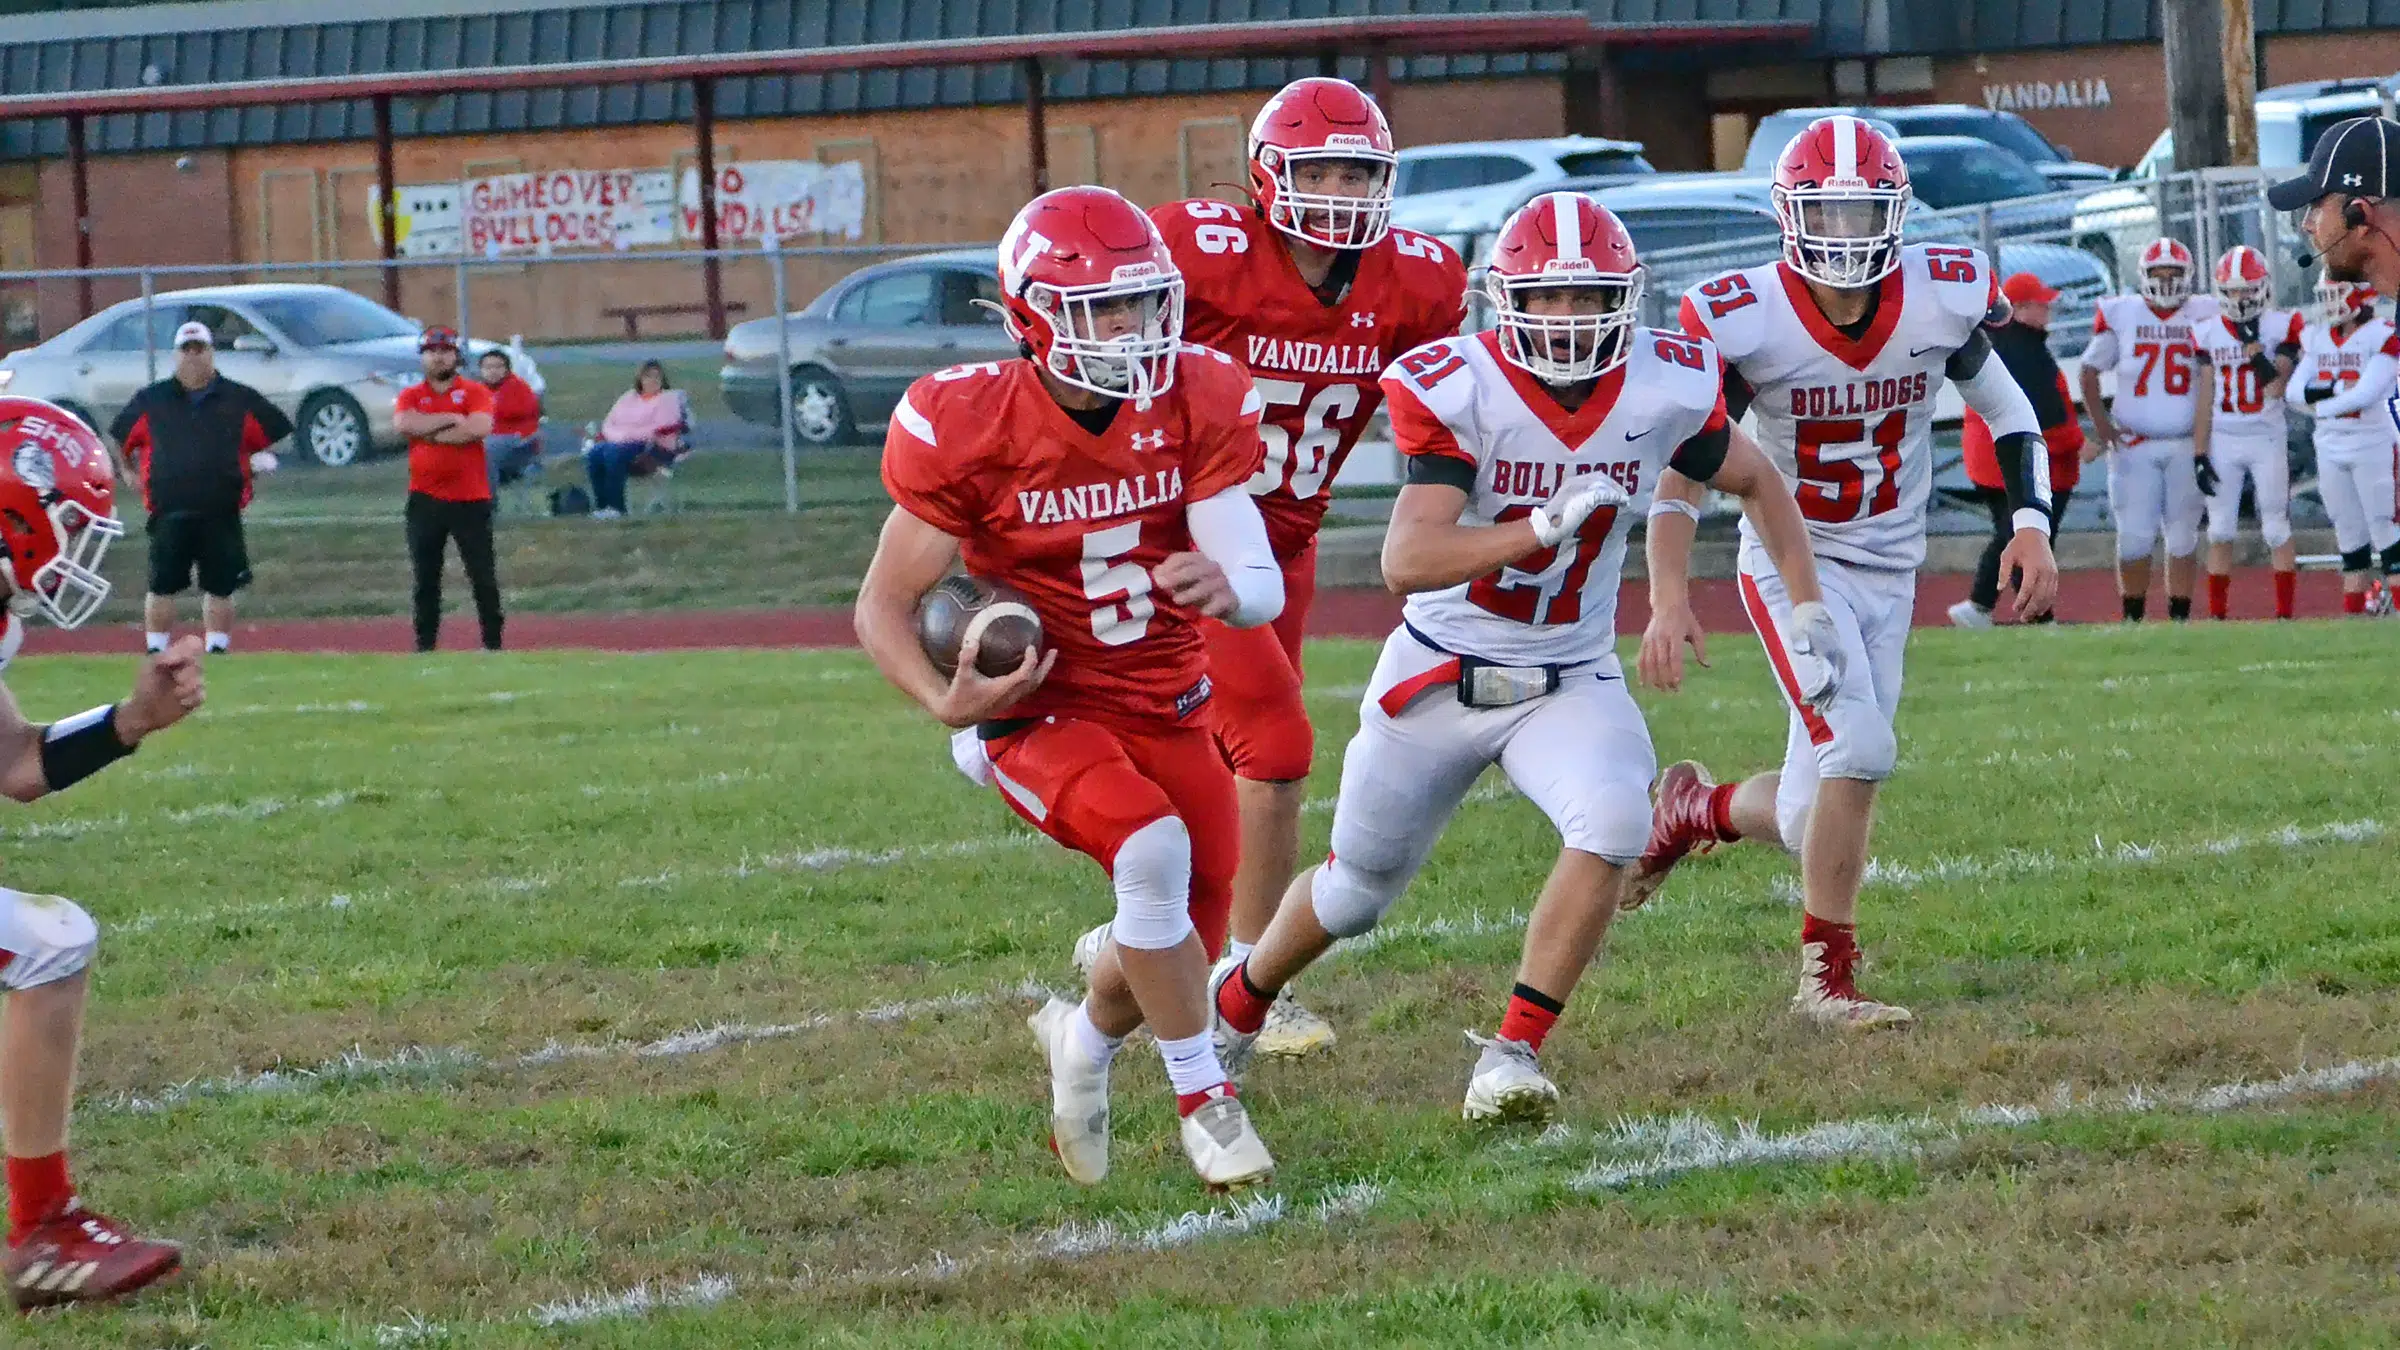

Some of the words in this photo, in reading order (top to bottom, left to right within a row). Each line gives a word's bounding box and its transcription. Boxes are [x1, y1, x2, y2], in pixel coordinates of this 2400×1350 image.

[1982, 78, 2112, 111] VANDALIA
[1332, 135, 1367, 145] Riddell
[1827, 179, 1864, 187] Riddell
[1184, 201, 1249, 255] 56
[1118, 266, 1156, 278] Riddell
[1550, 261, 1590, 271] Riddell
[1924, 247, 1975, 284] 51
[1698, 273, 1759, 319] 51
[1247, 335, 1381, 374] VANDALIA
[1395, 343, 1468, 392] 21
[2132, 342, 2193, 397] 76
[1790, 371, 1928, 417] BULLDOGS
[2220, 363, 2264, 414] 10
[16, 415, 85, 469] SHS
[1249, 376, 1362, 501] 56
[1794, 408, 1909, 524] 51
[1017, 467, 1184, 525] VANDALIA
[1079, 520, 1156, 647] 5
